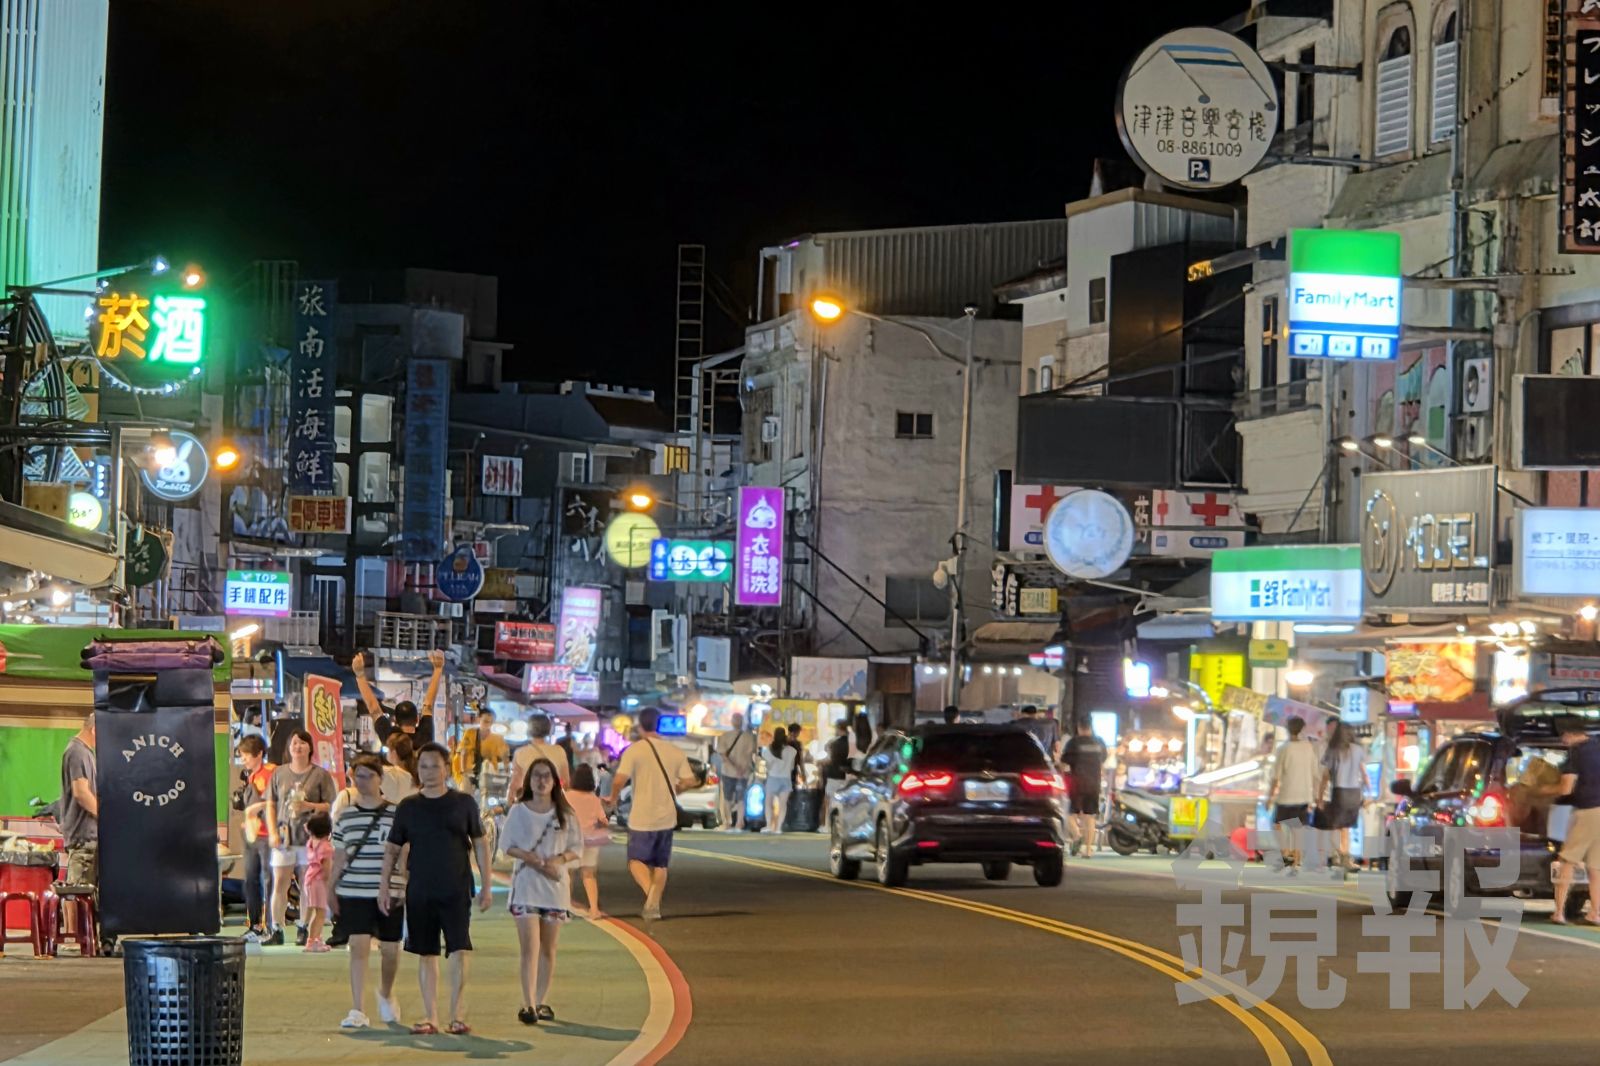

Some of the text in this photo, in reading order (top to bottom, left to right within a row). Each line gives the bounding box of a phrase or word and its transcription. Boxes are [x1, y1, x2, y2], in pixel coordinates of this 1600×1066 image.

[1133, 104, 1267, 142] 津津音樂客棧
[1156, 139, 1242, 157] 08-8861009
[1294, 287, 1395, 311] FamilyMart
[98, 292, 206, 363] 菸酒
[294, 284, 328, 485] 旅南活海鮮
[255, 572, 278, 584] TOP
